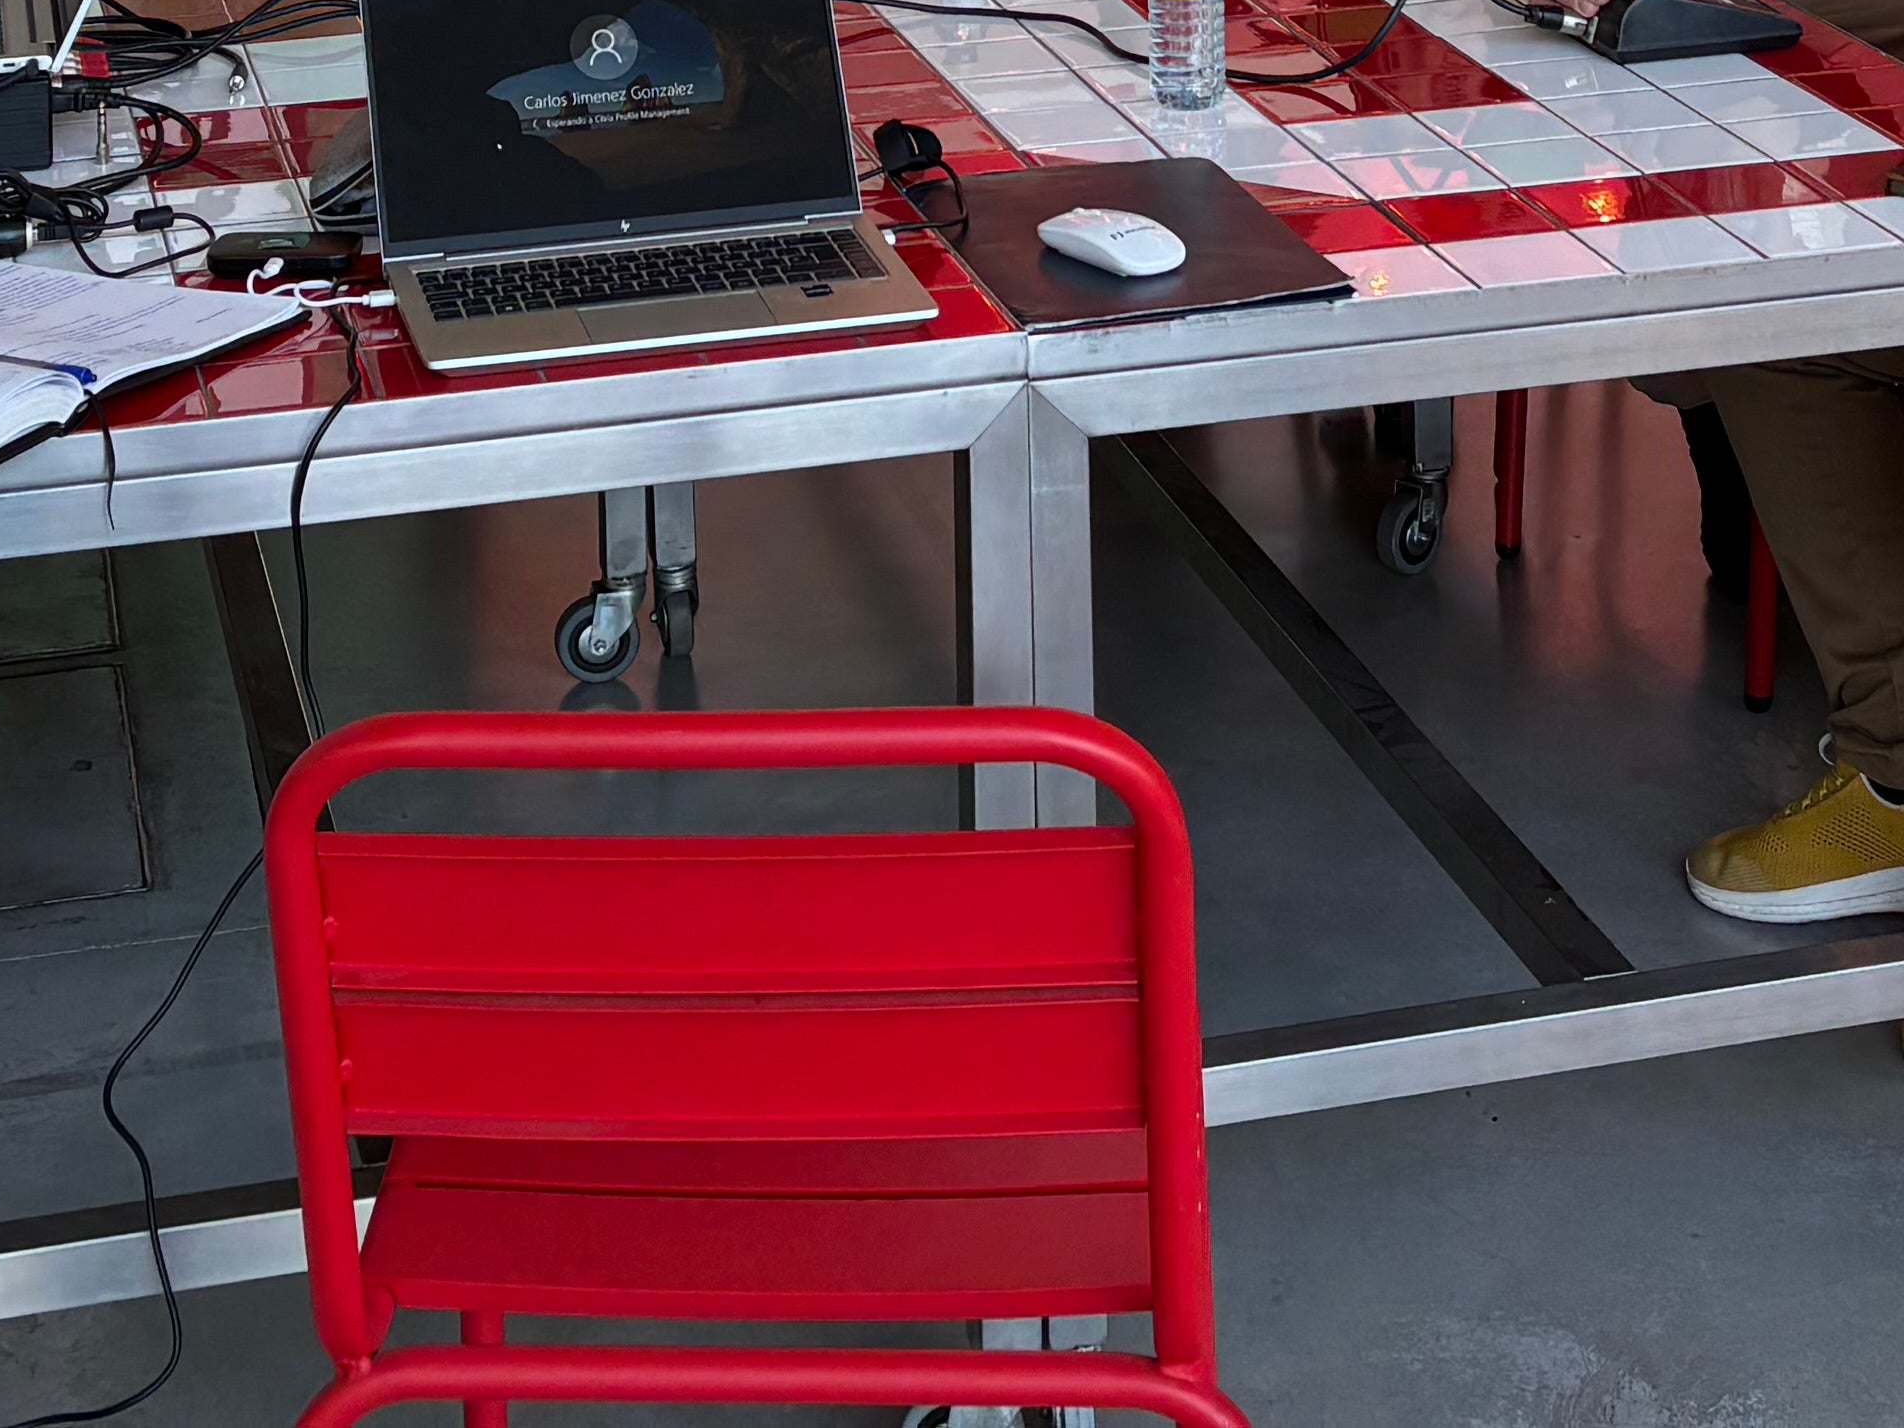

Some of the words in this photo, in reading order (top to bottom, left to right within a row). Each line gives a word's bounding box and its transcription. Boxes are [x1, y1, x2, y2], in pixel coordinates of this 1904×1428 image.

[524, 95, 568, 110] Carlos
[572, 89, 627, 106] Jimenez
[630, 82, 694, 100] Gonzalez
[640, 107, 690, 120] Management
